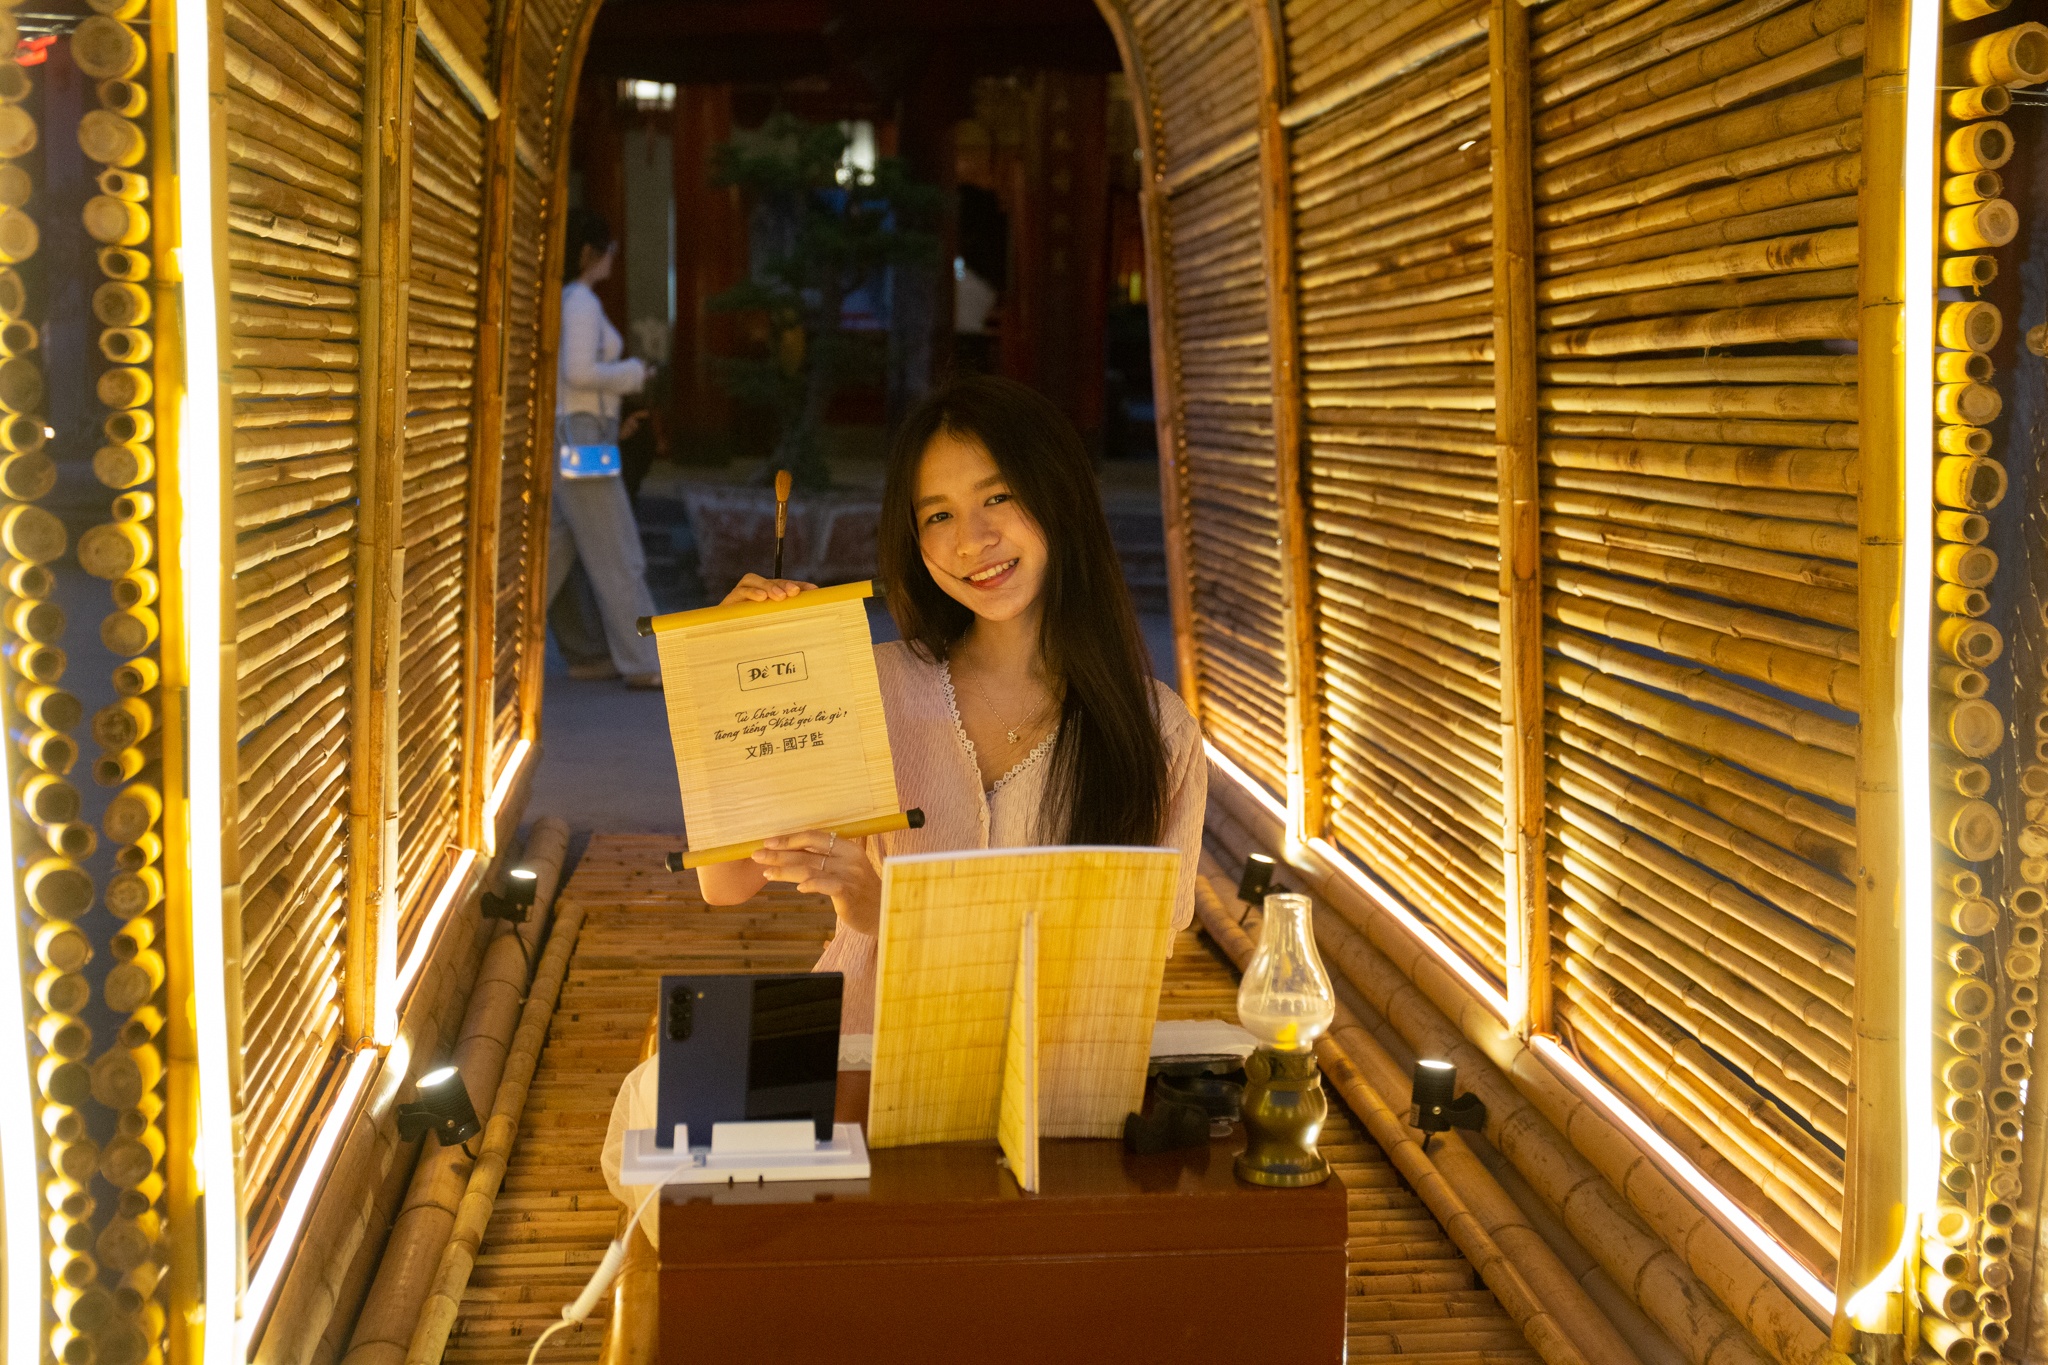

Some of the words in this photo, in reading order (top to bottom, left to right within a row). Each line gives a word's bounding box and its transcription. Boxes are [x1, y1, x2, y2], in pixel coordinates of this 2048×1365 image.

[771, 662, 796, 675] Thi
[782, 702, 807, 716] này
[714, 729, 740, 742] trong
[743, 722, 767, 737] tiếng
[768, 717, 795, 731] Việt
[794, 715, 813, 730] gọi
[815, 710, 827, 722] là
